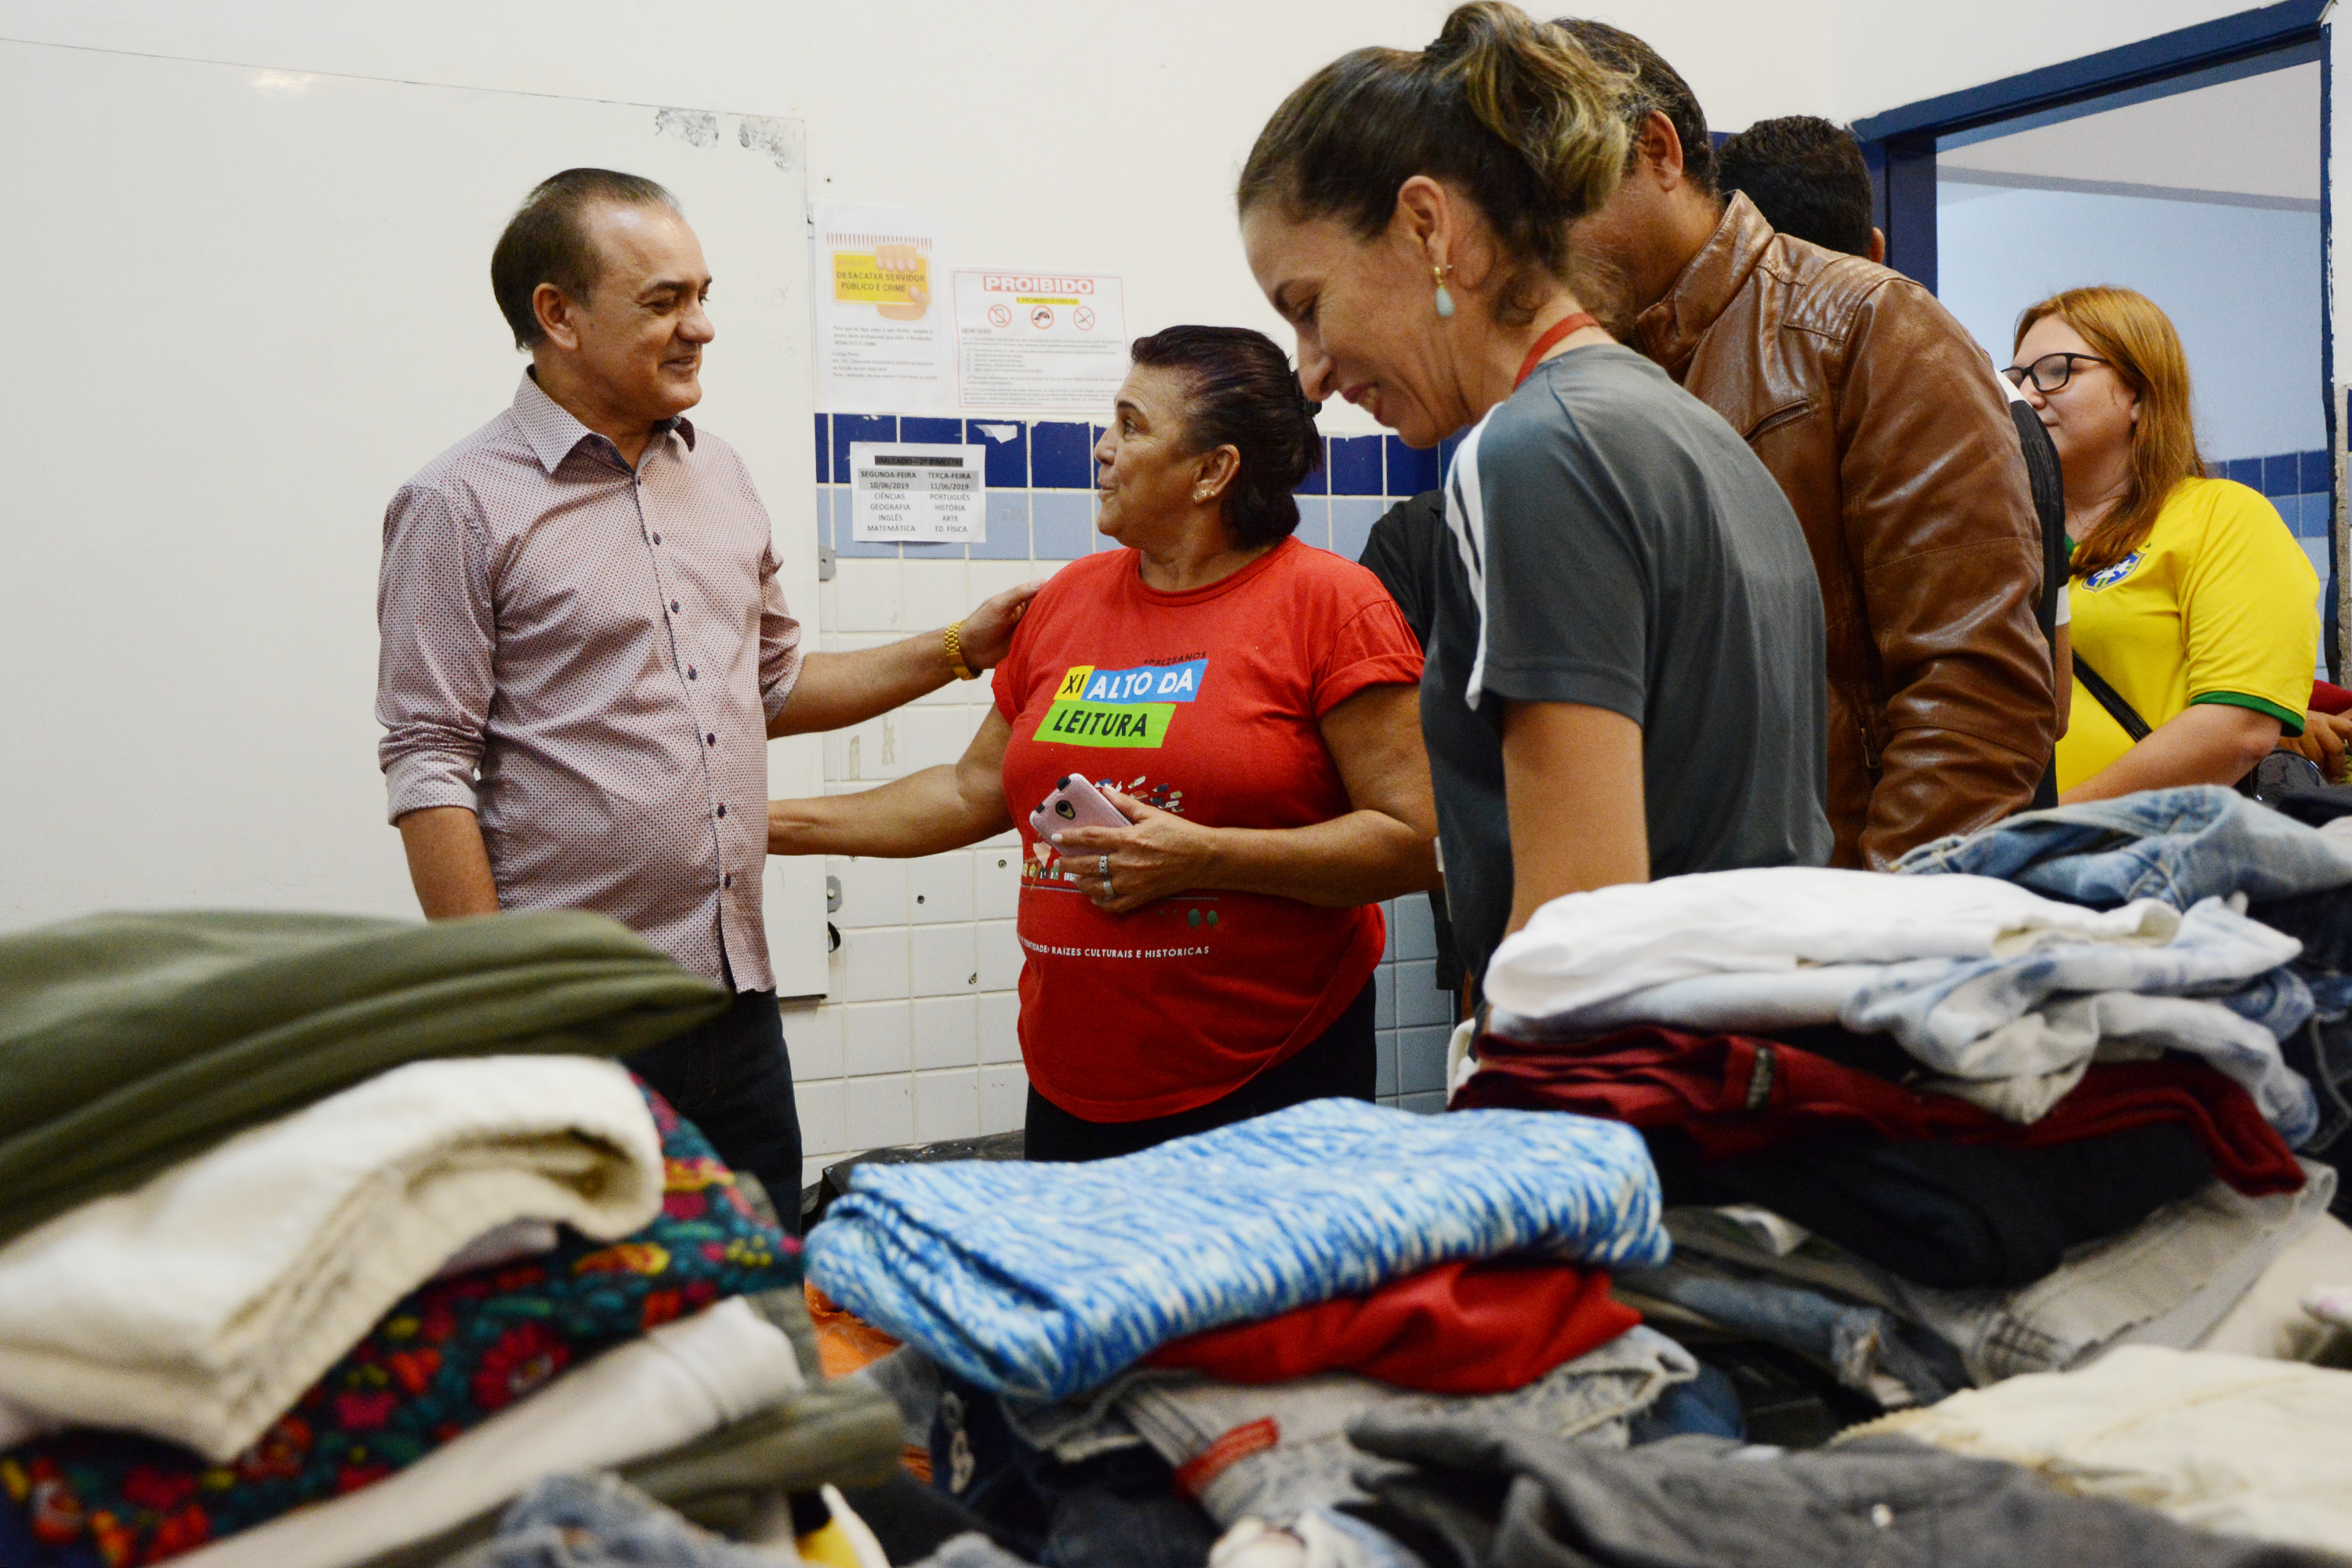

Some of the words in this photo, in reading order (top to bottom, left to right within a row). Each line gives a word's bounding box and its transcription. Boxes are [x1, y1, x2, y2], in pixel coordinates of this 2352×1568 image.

[837, 271, 883, 280] DESACATAR
[883, 284, 906, 292] CRIME
[985, 277, 1093, 294] PROIBIDO
[870, 481, 909, 490] 10/06/2019
[1062, 673, 1086, 694] XI
[1087, 672, 1152, 699] ALTO
[1157, 668, 1192, 694] DA
[1053, 710, 1147, 737] LEITURA
[1052, 946, 1081, 956] RAÍZES
[1084, 949, 1133, 958] CULTURAIS
[1136, 949, 1142, 958] E
[1145, 946, 1209, 958] HISTÓRICAS
